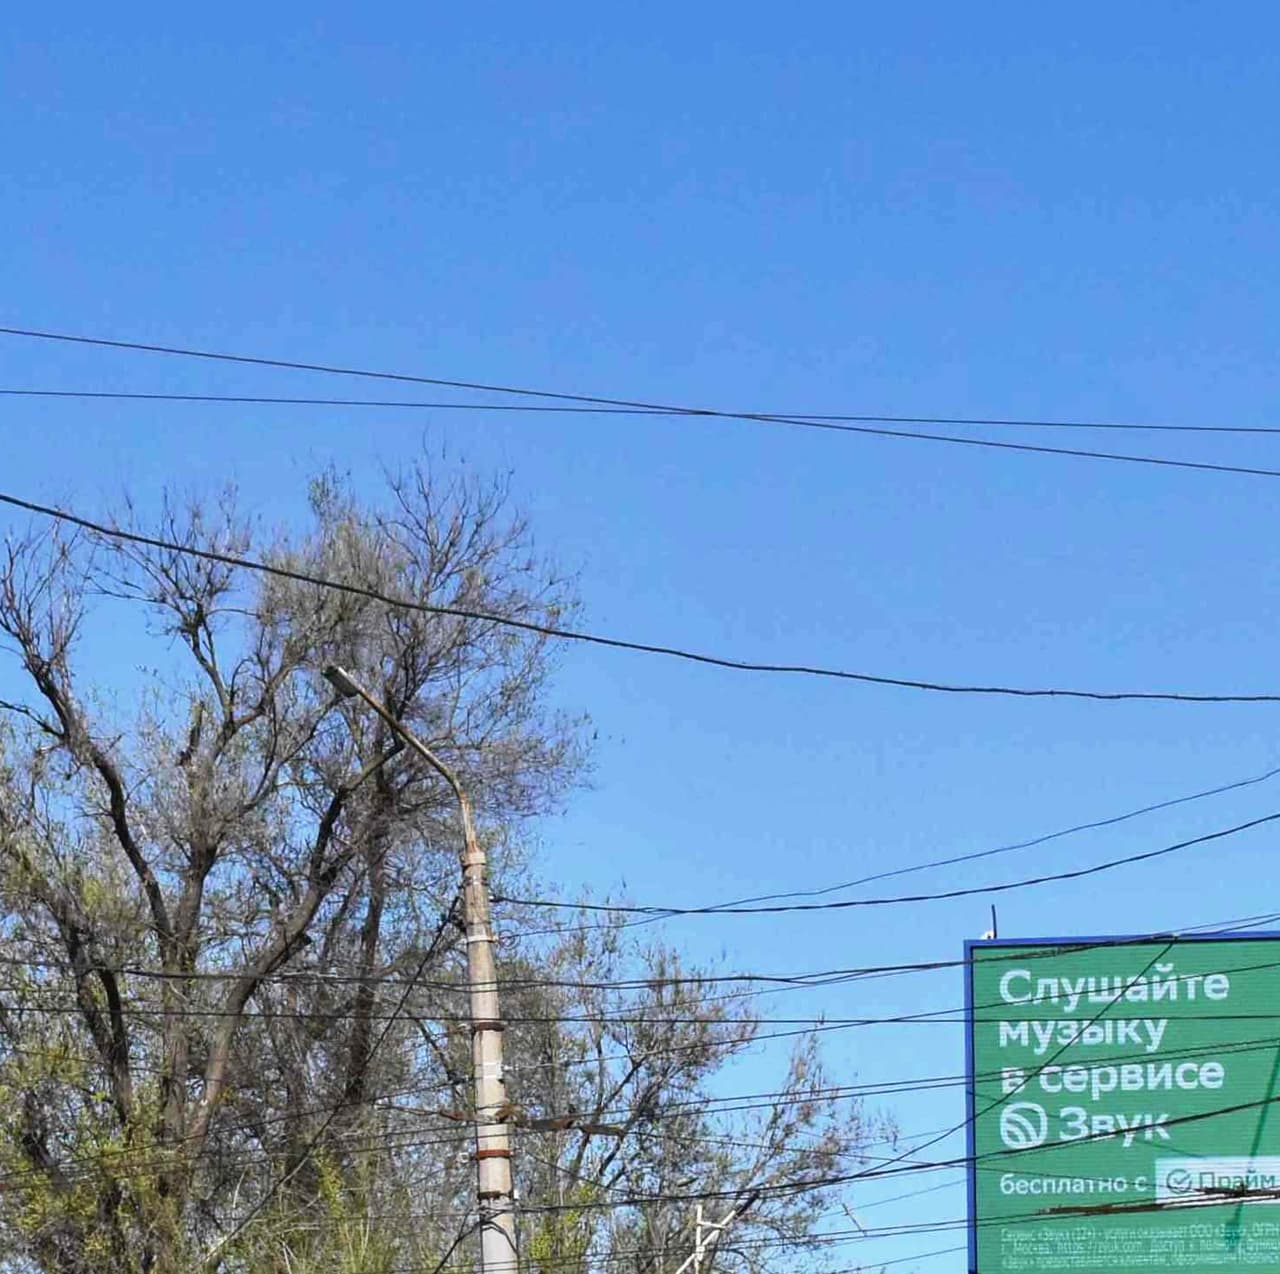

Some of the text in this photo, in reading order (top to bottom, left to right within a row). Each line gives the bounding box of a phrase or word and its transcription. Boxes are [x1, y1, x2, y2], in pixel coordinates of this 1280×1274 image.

[999, 963, 1230, 1013] Слушайте
[999, 1018, 1169, 1055] музыку
[1001, 1061, 1226, 1101] в сервисе
[1059, 1106, 1172, 1147] Звук
[1000, 1173, 1149, 1195] бесплатно с
